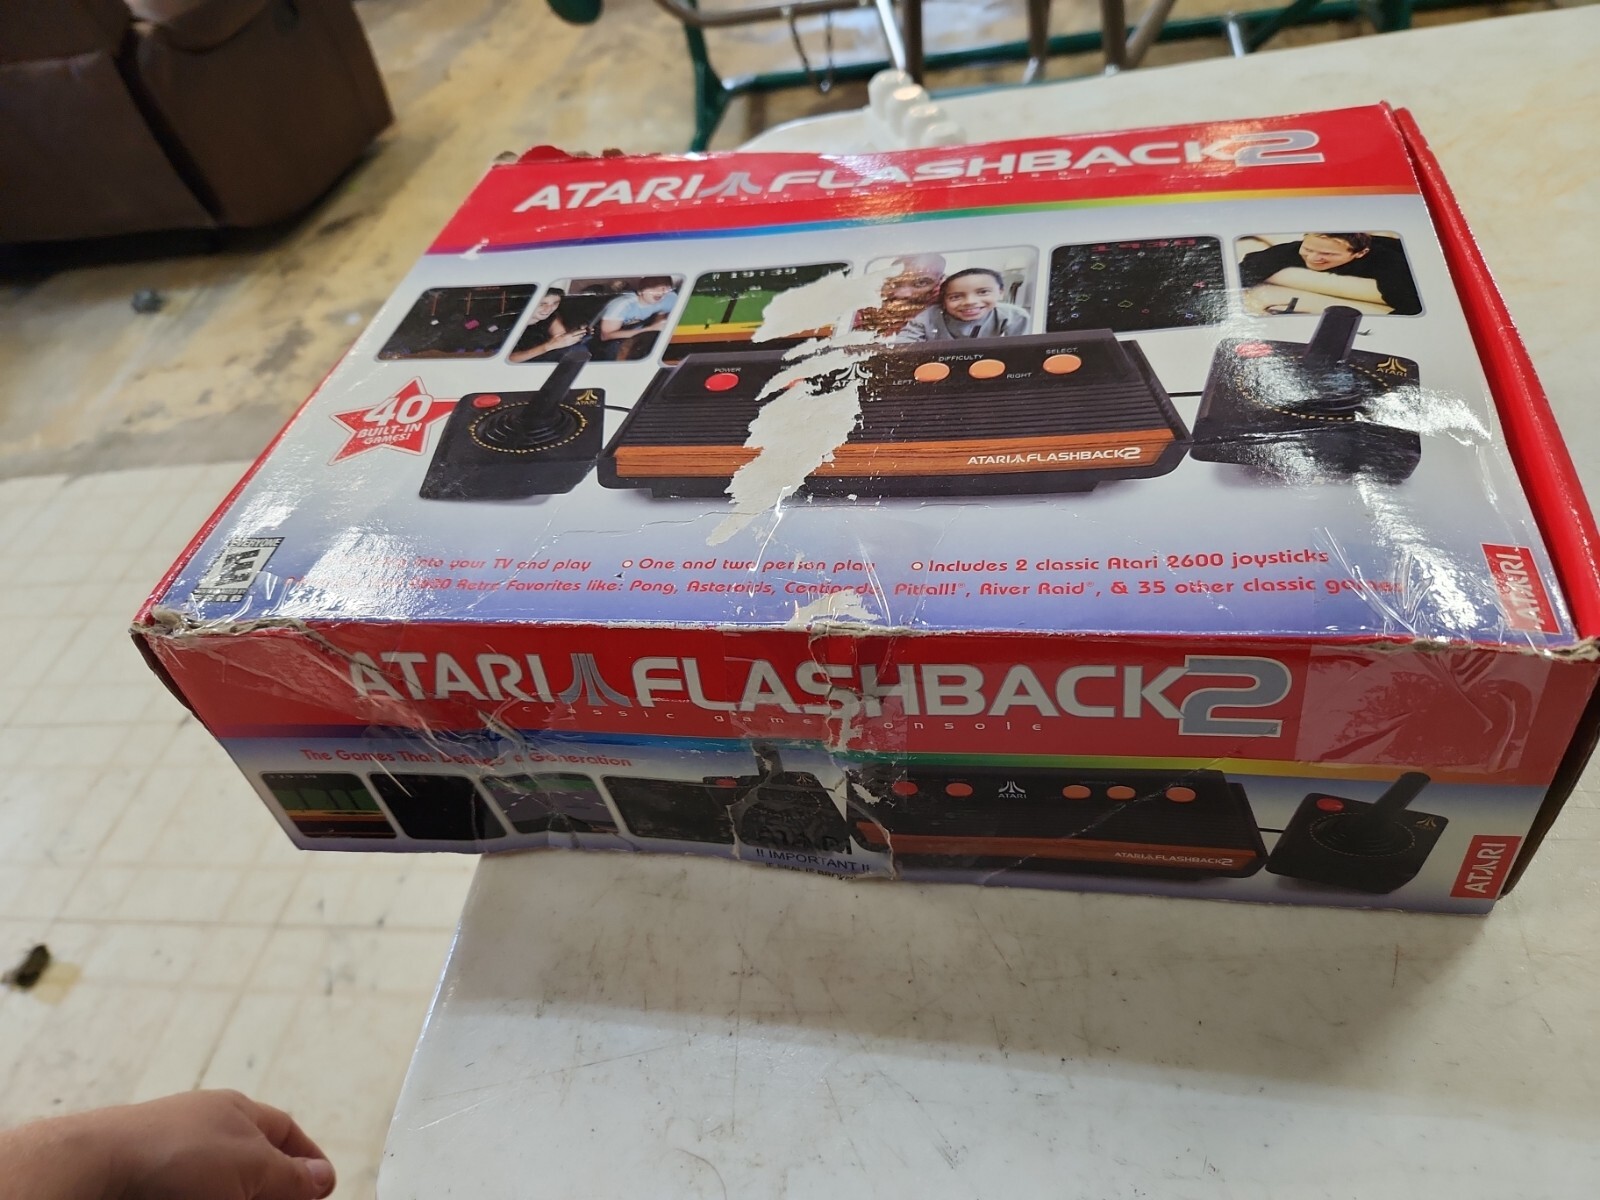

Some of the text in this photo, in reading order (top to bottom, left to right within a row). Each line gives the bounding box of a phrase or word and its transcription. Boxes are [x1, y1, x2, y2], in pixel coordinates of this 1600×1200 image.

[511, 173, 705, 213] ATARI
[937, 353, 984, 362] DIFFICULTY
[713, 366, 742, 374] POWER
[1006, 372, 1033, 380] RIGHT
[1375, 367, 1408, 378] ATARI
[364, 395, 432, 426] 40
[357, 422, 422, 440] BUILT-IN
[363, 433, 411, 445] GAMES!
[966, 446, 1141, 466] ATARI FLASHBACK2
[414, 556, 443, 569] into
[449, 559, 487, 572] your
[493, 558, 513, 570] TV
[516, 558, 550, 570] and
[552, 559, 592, 573] play
[638, 558, 876, 574] One and two person play
[928, 549, 1329, 573] Includes 2 classic Atari 2600 joysticks
[505, 579, 581, 592] Favorites
[586, 579, 623, 592] like:
[629, 580, 679, 595] Pong,
[686, 580, 776, 596] Asteroids,
[979, 582, 1031, 595] River
[1109, 581, 1129, 594] &
[1137, 580, 1166, 594] 35
[1174, 578, 1235, 593] other
[1243, 577, 1317, 593] classic
[1495, 552, 1546, 625] ATARI
[348, 652, 1294, 738] ATARI FLASHBACK2
[713, 713, 812, 726] game
[300, 749, 333, 761] The
[335, 749, 396, 762] Games
[397, 750, 436, 763] That
[529, 751, 633, 769] Generation
[769, 850, 857, 872] IMPORTANT
[1113, 851, 1145, 860] ATARI
[1463, 842, 1507, 894] ATARI
